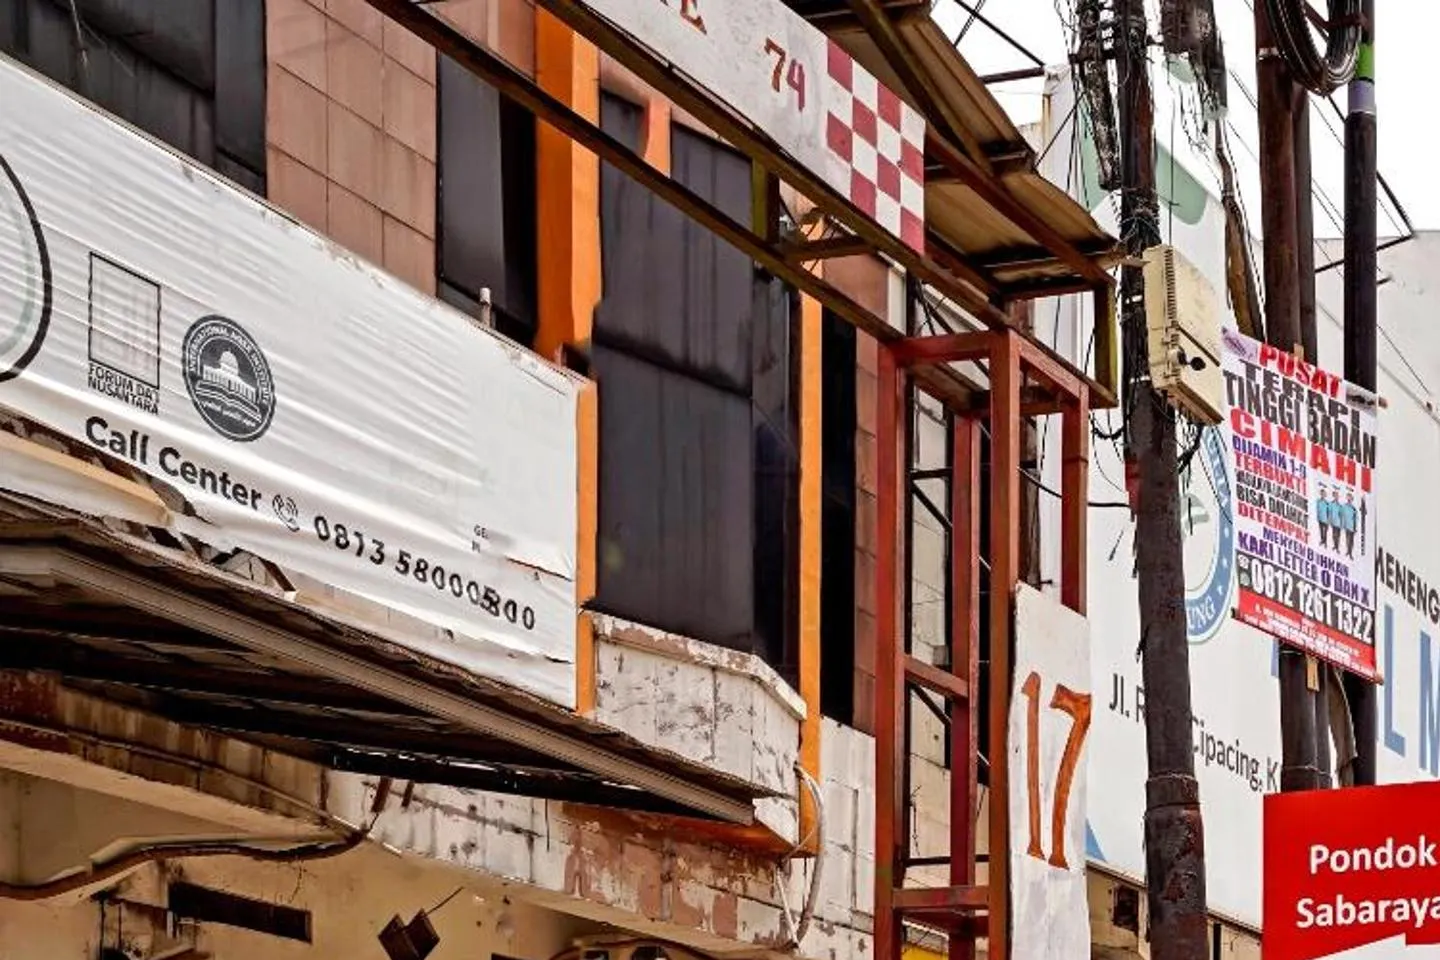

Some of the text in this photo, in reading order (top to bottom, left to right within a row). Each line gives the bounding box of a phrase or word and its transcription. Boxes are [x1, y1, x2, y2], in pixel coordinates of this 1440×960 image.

[87, 375, 160, 415] NUSANTARA
[89, 364, 134, 393] FORUM
[1239, 358, 1361, 429] TERAPI
[1259, 342, 1342, 398] PUSAT
[1222, 369, 1376, 468] TINGGI BADAN
[86, 416, 149, 455] Call
[158, 447, 262, 511] Center
[1230, 407, 1373, 493] CIMAHI
[1238, 531, 1274, 560] KAKI
[1251, 557, 1294, 608] 0812
[1109, 673, 1130, 718] Jl.
[1020, 671, 1091, 869] 17
[1308, 834, 1438, 874] Pondok
